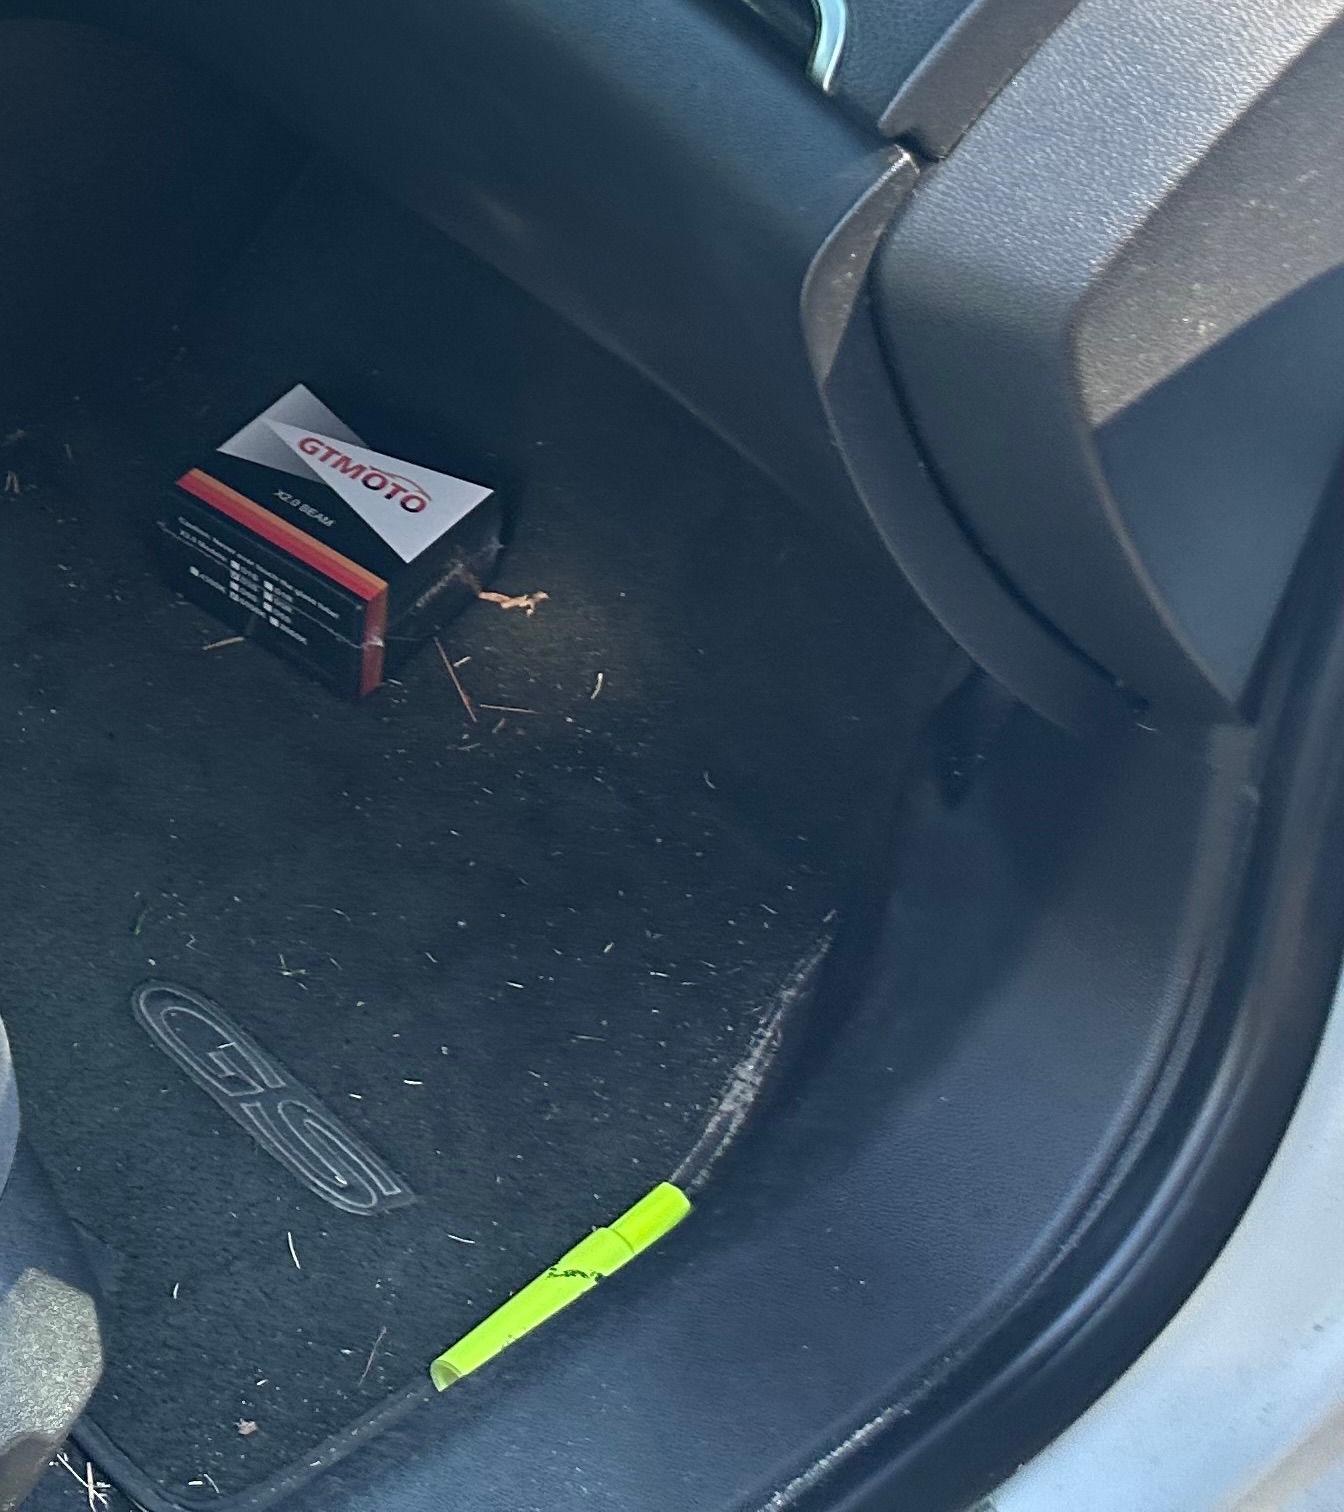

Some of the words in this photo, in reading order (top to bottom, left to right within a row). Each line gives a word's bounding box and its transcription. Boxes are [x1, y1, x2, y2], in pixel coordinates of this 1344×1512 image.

[297, 436, 428, 514] GTMOTO
[298, 501, 337, 528] BEAM
[132, 980, 413, 1216] GS
